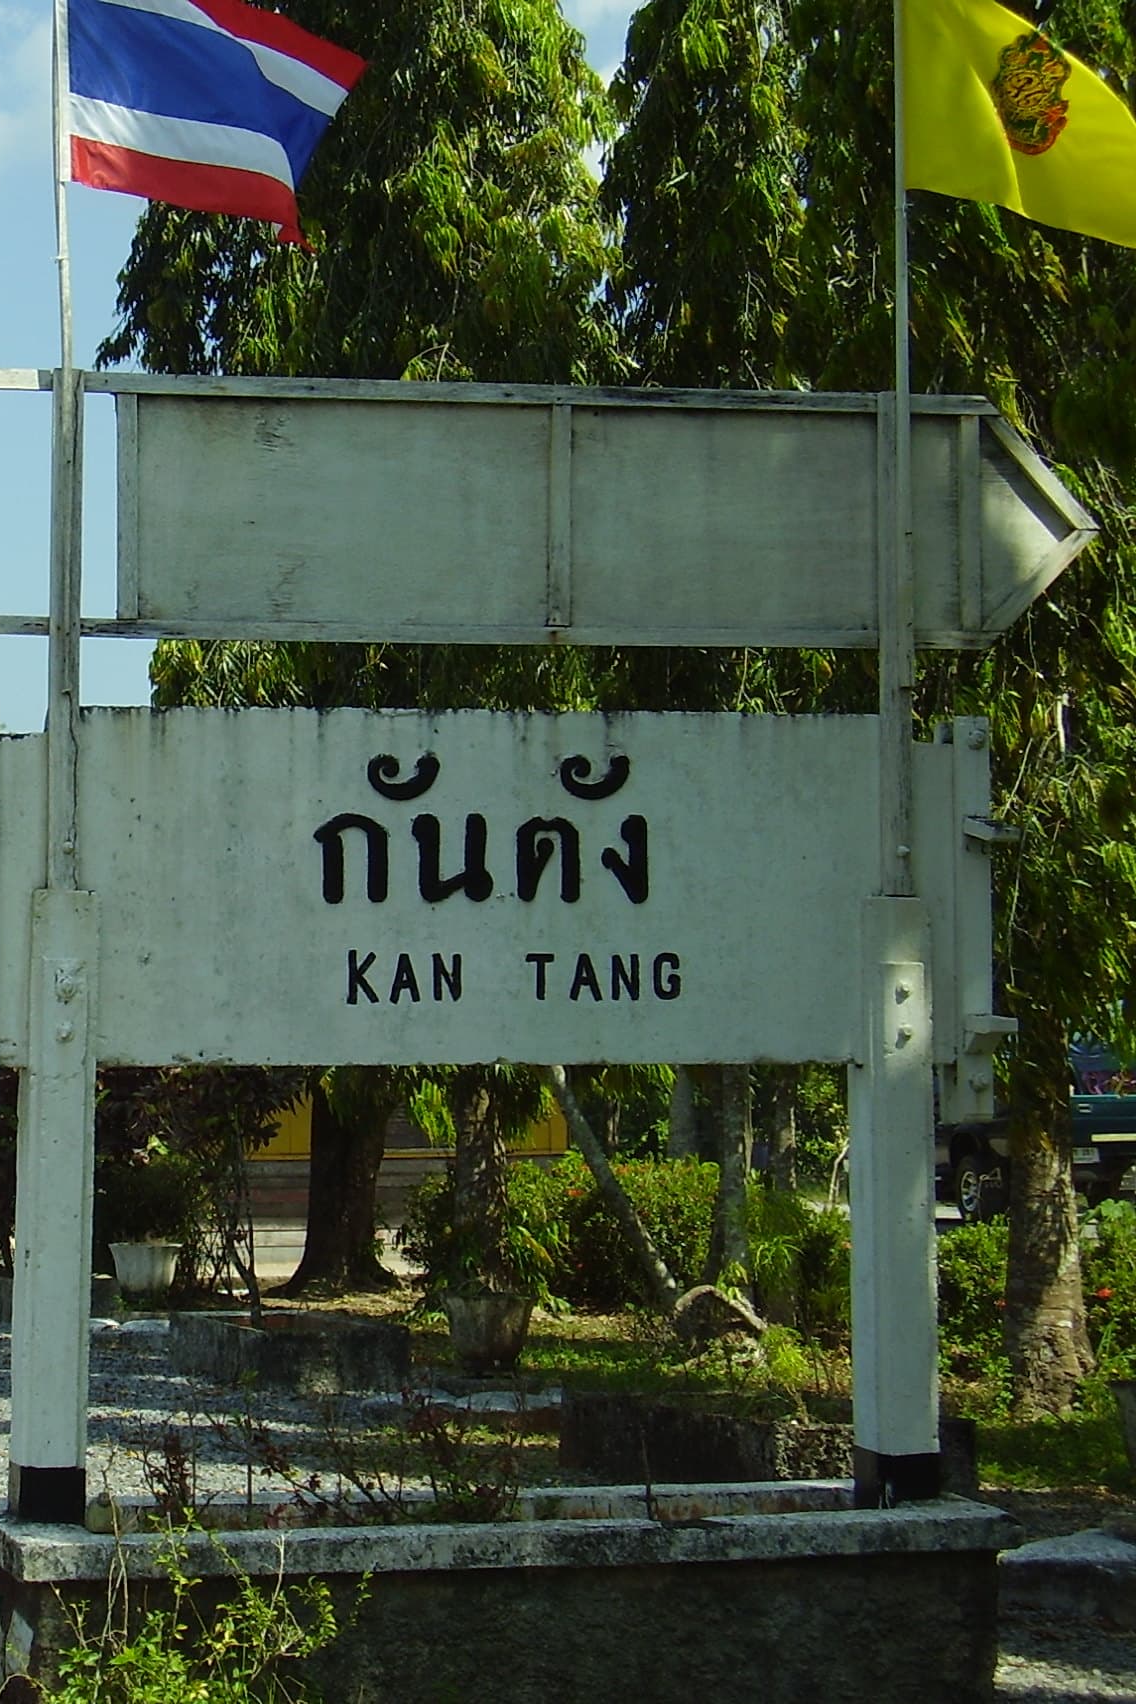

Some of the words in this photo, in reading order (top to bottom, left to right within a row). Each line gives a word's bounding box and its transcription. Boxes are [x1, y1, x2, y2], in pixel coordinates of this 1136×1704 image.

[313, 752, 650, 905] กันตัง
[346, 949, 463, 1005] KAN
[524, 951, 682, 1003] TANG
